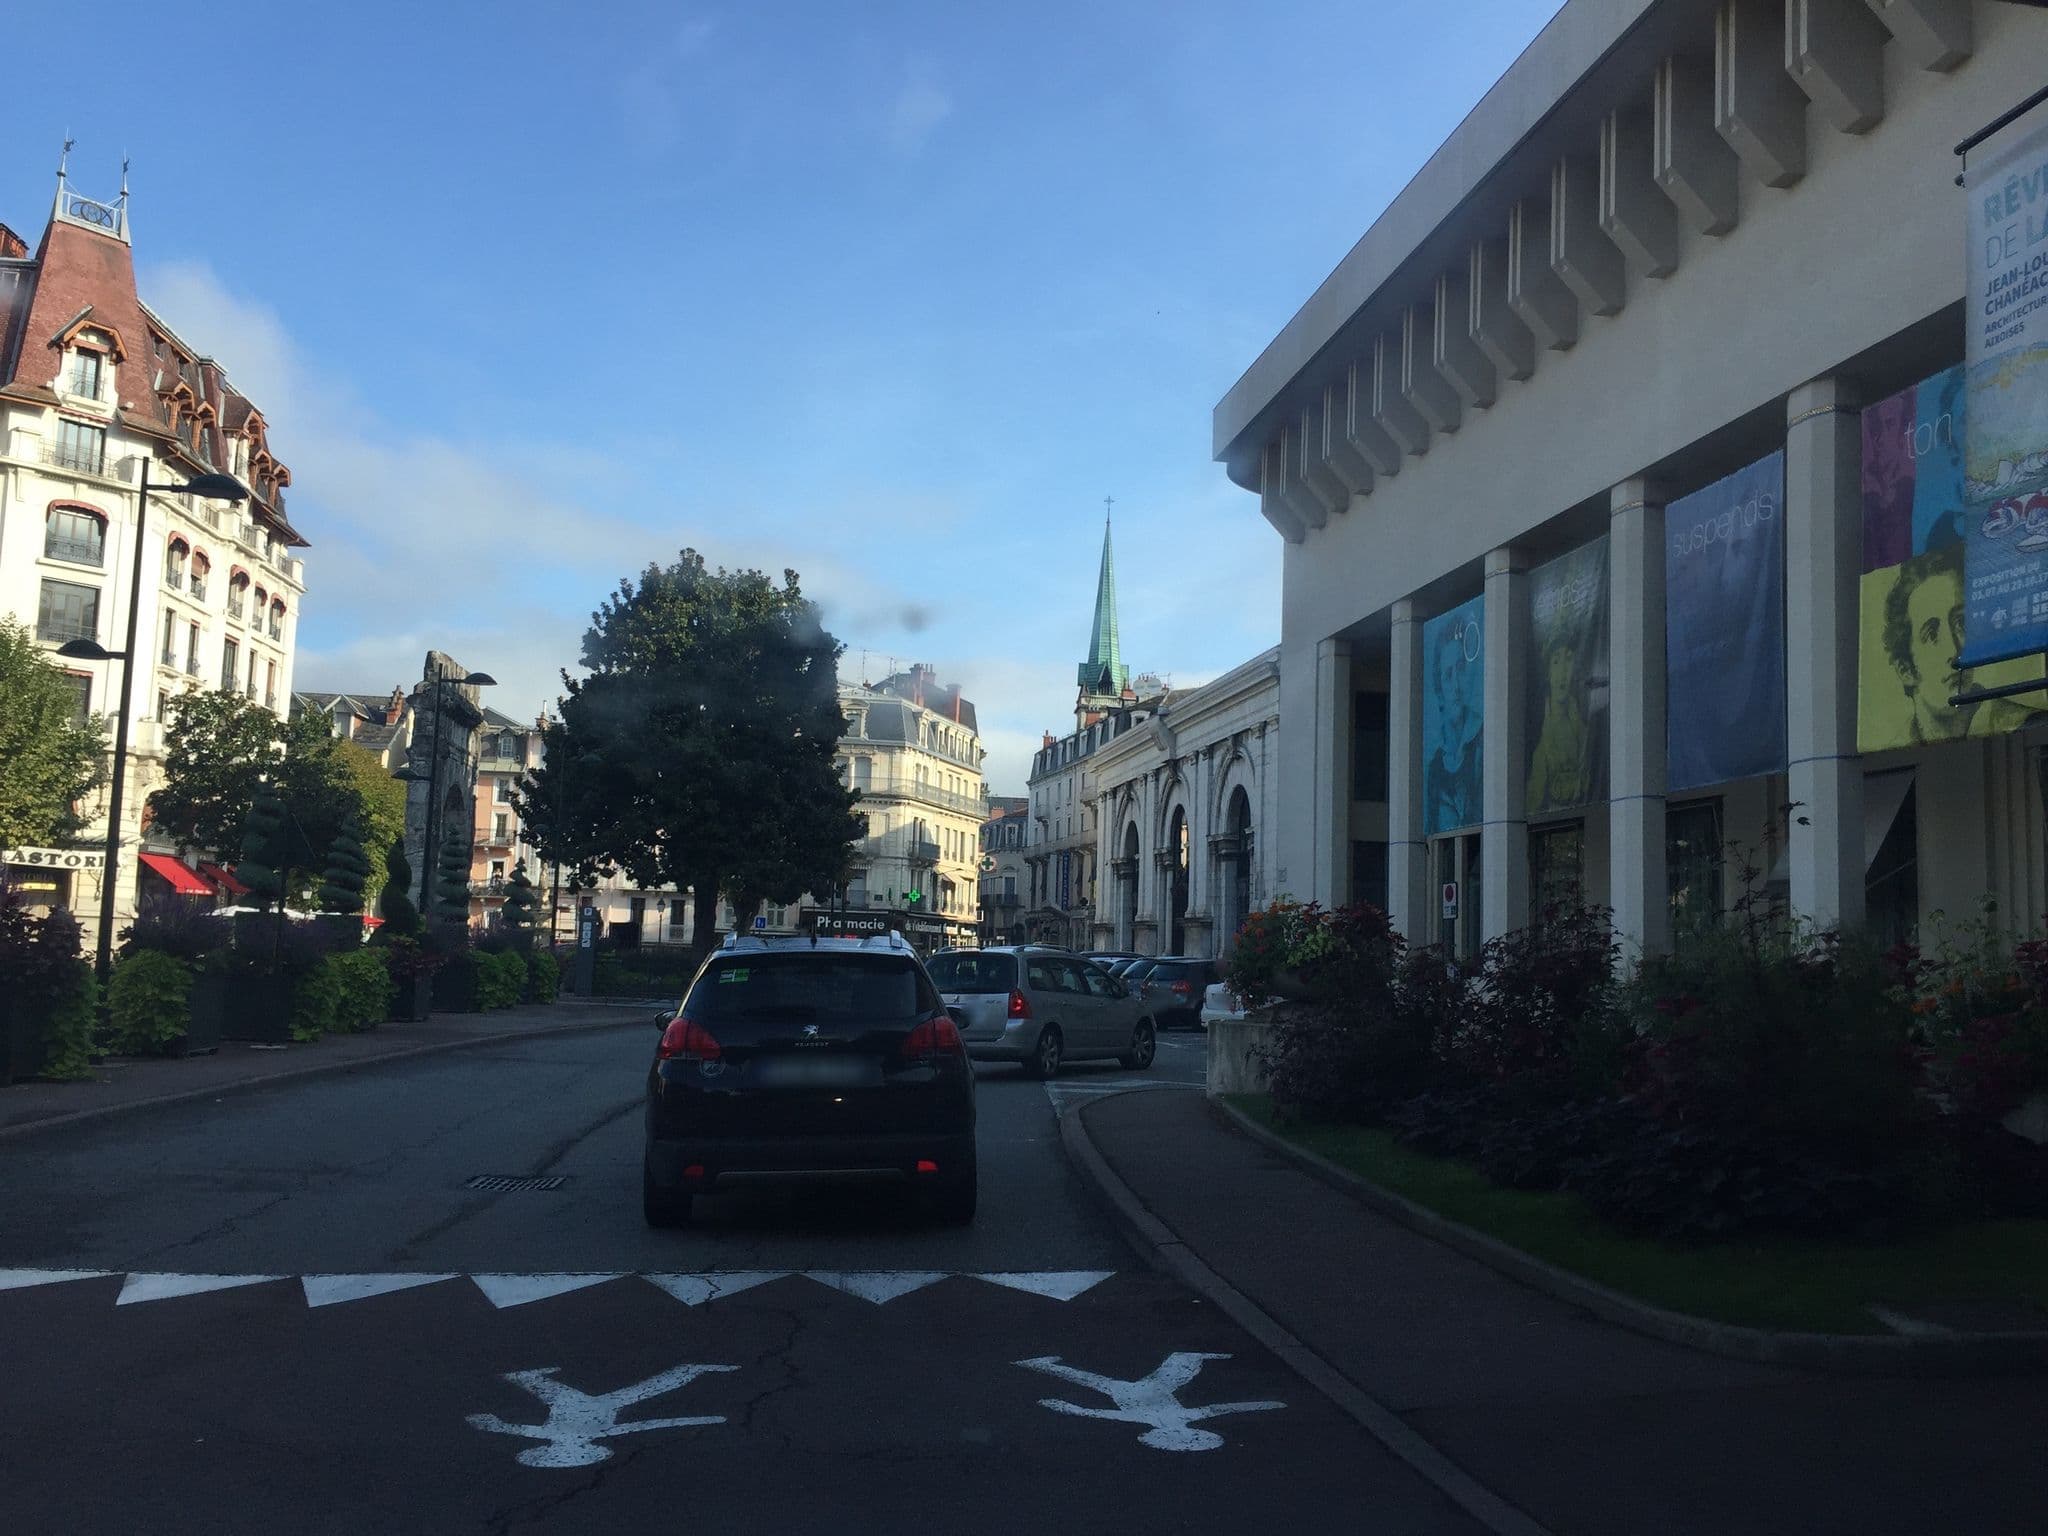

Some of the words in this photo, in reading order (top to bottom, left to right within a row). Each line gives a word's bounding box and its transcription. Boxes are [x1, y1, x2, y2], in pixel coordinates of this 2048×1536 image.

[1986, 223, 2017, 268] DE
[1985, 271, 2048, 315] CHANÉAC
[1985, 321, 2024, 348] AIXOISES
[1904, 413, 1952, 459] ton
[1672, 490, 1775, 557] suspends
[10, 850, 120, 868] ASTORI
[817, 916, 885, 929] Phamacie
